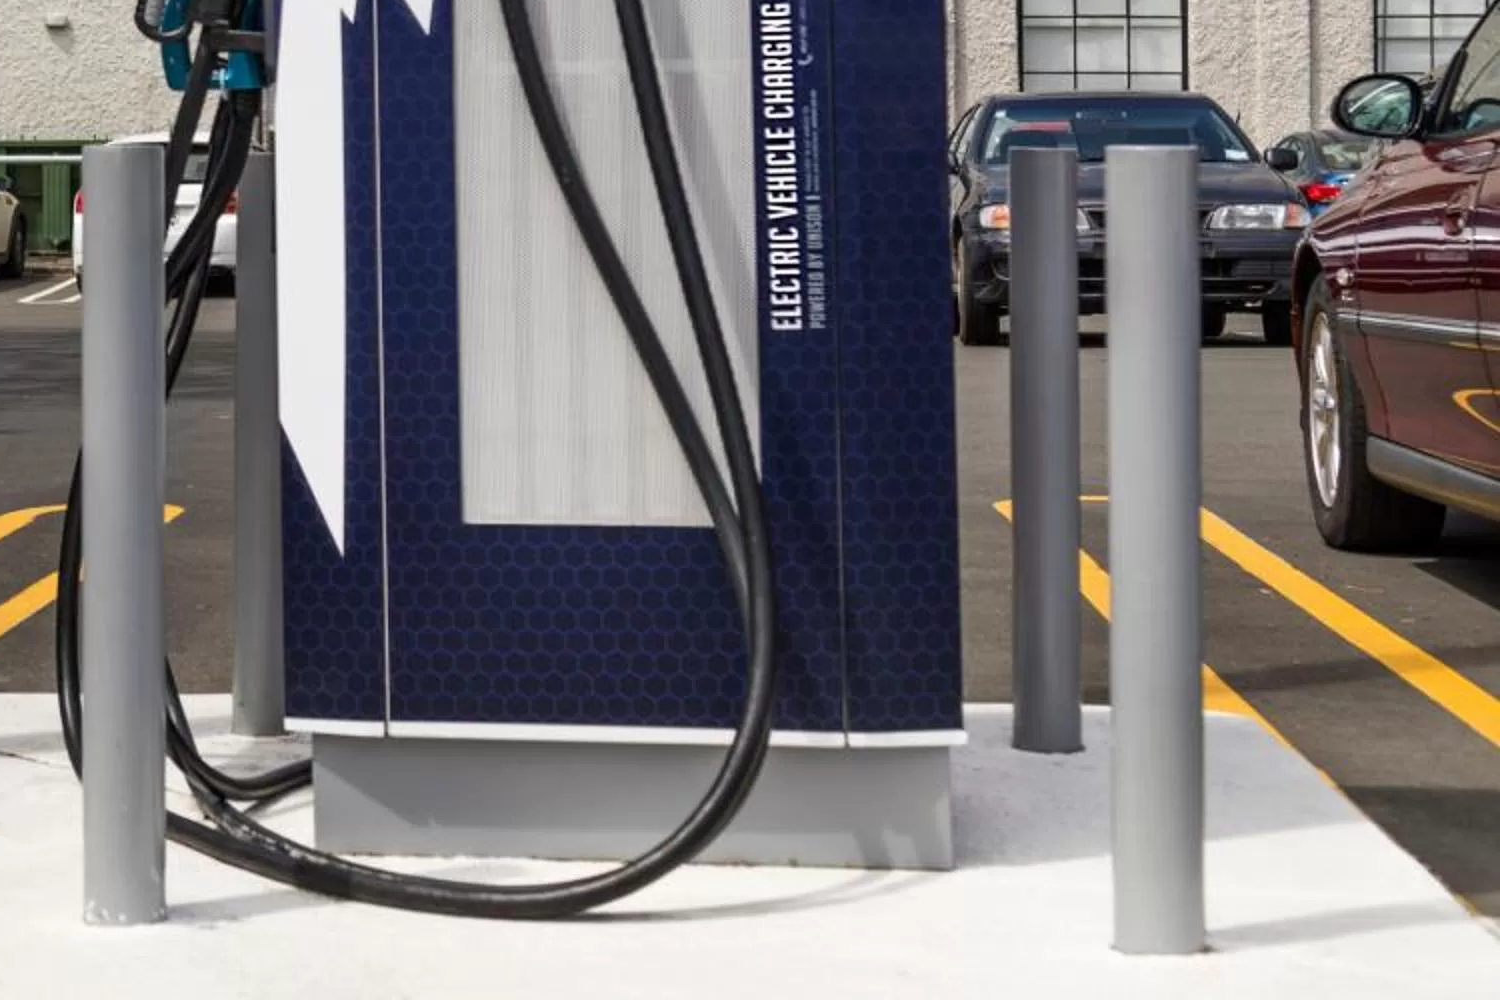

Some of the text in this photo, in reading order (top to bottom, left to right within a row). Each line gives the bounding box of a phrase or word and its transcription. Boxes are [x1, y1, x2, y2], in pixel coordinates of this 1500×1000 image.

[761, 1, 795, 117] CHARGING
[766, 125, 799, 218] VEHICLE
[805, 204, 824, 249] UNISON
[806, 252, 825, 269] BY
[768, 226, 802, 331] ELECTRIC
[807, 272, 826, 329] POWERED
